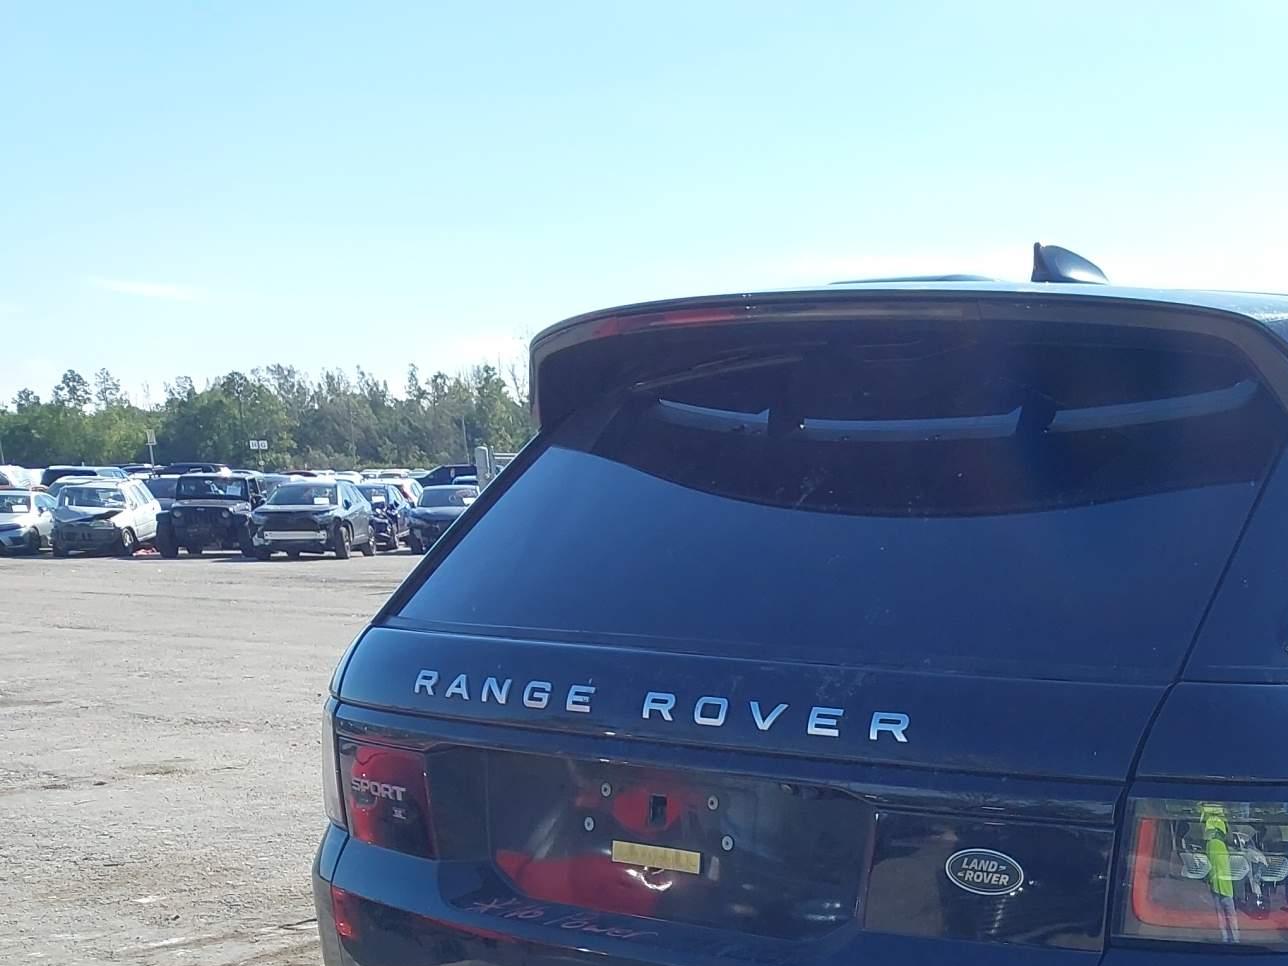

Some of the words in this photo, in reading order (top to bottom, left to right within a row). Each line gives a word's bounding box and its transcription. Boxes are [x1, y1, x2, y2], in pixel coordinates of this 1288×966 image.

[414, 669, 596, 713] RANGE
[642, 691, 910, 743] ROVER
[351, 777, 407, 801] SPORT
[961, 857, 998, 872] LAND
[964, 870, 1010, 886] ROVER
